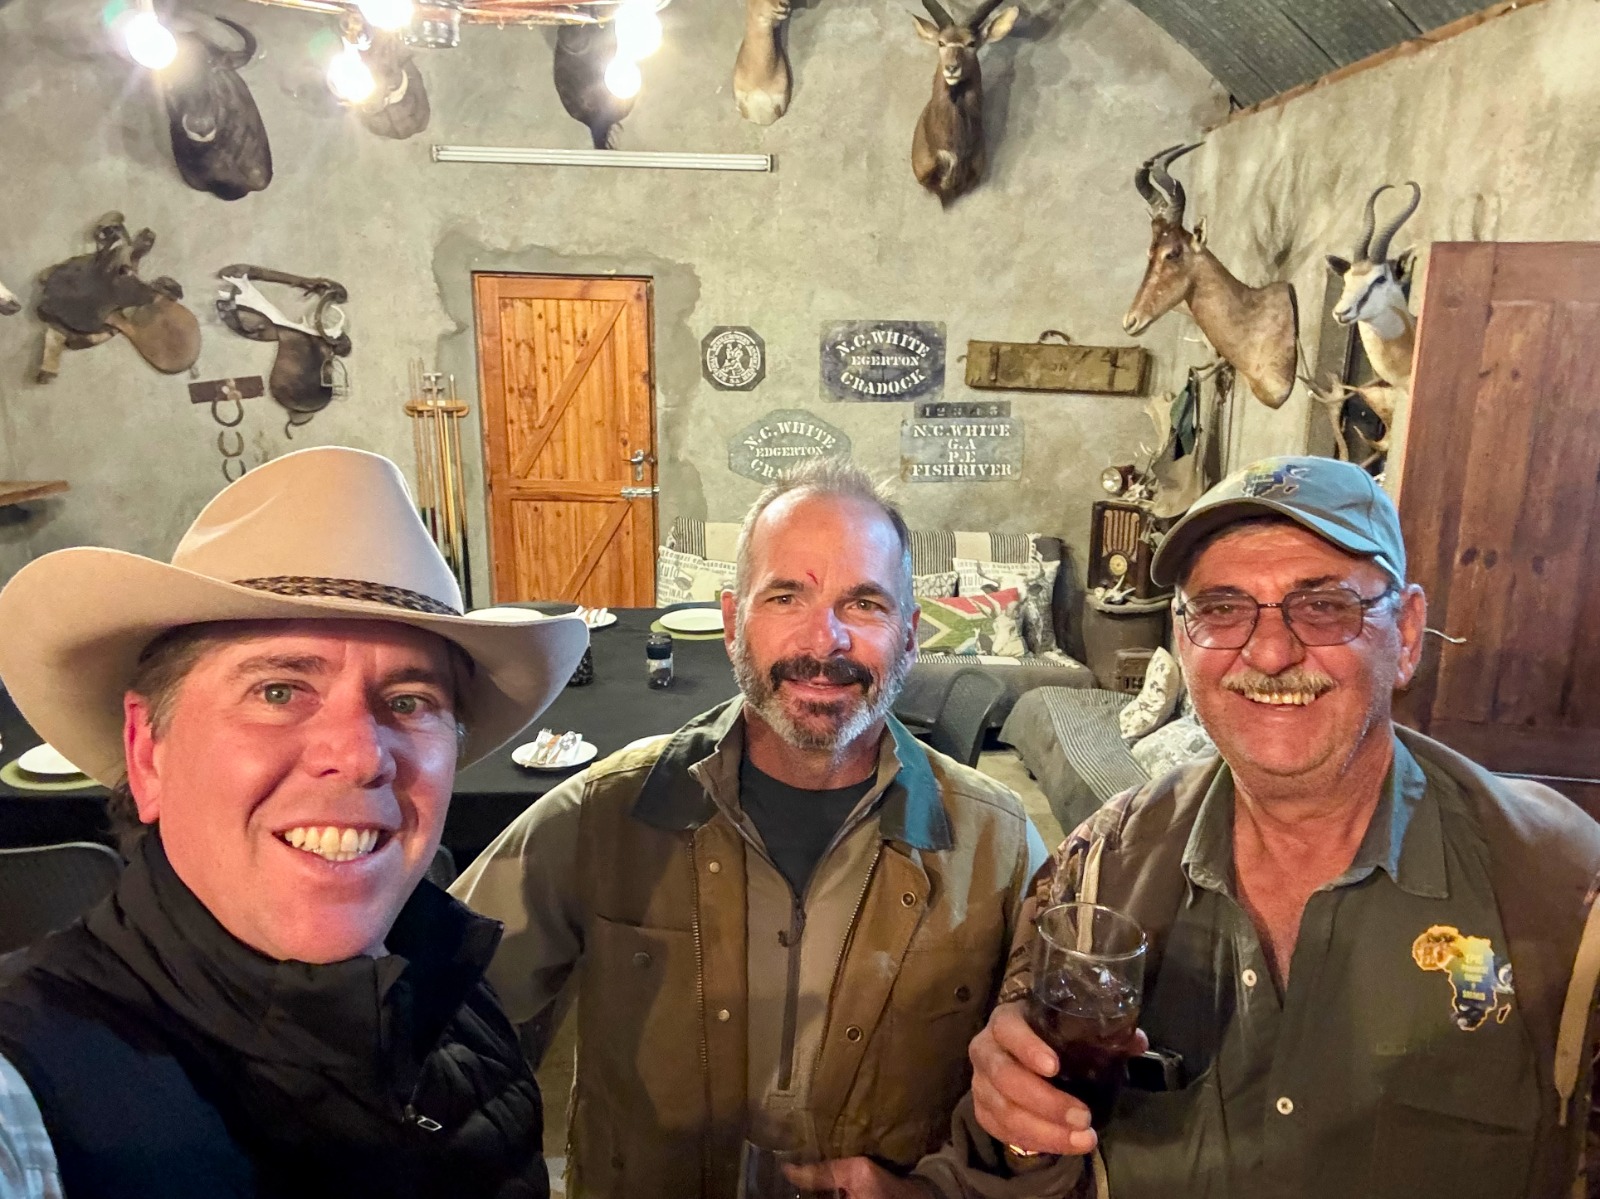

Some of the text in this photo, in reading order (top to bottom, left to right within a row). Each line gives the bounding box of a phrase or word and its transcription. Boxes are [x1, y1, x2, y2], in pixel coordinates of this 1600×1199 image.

[851, 355, 920, 367] EGERTON
[840, 368, 926, 395] CRADOCK
[755, 446, 824, 458] EDGERTON
